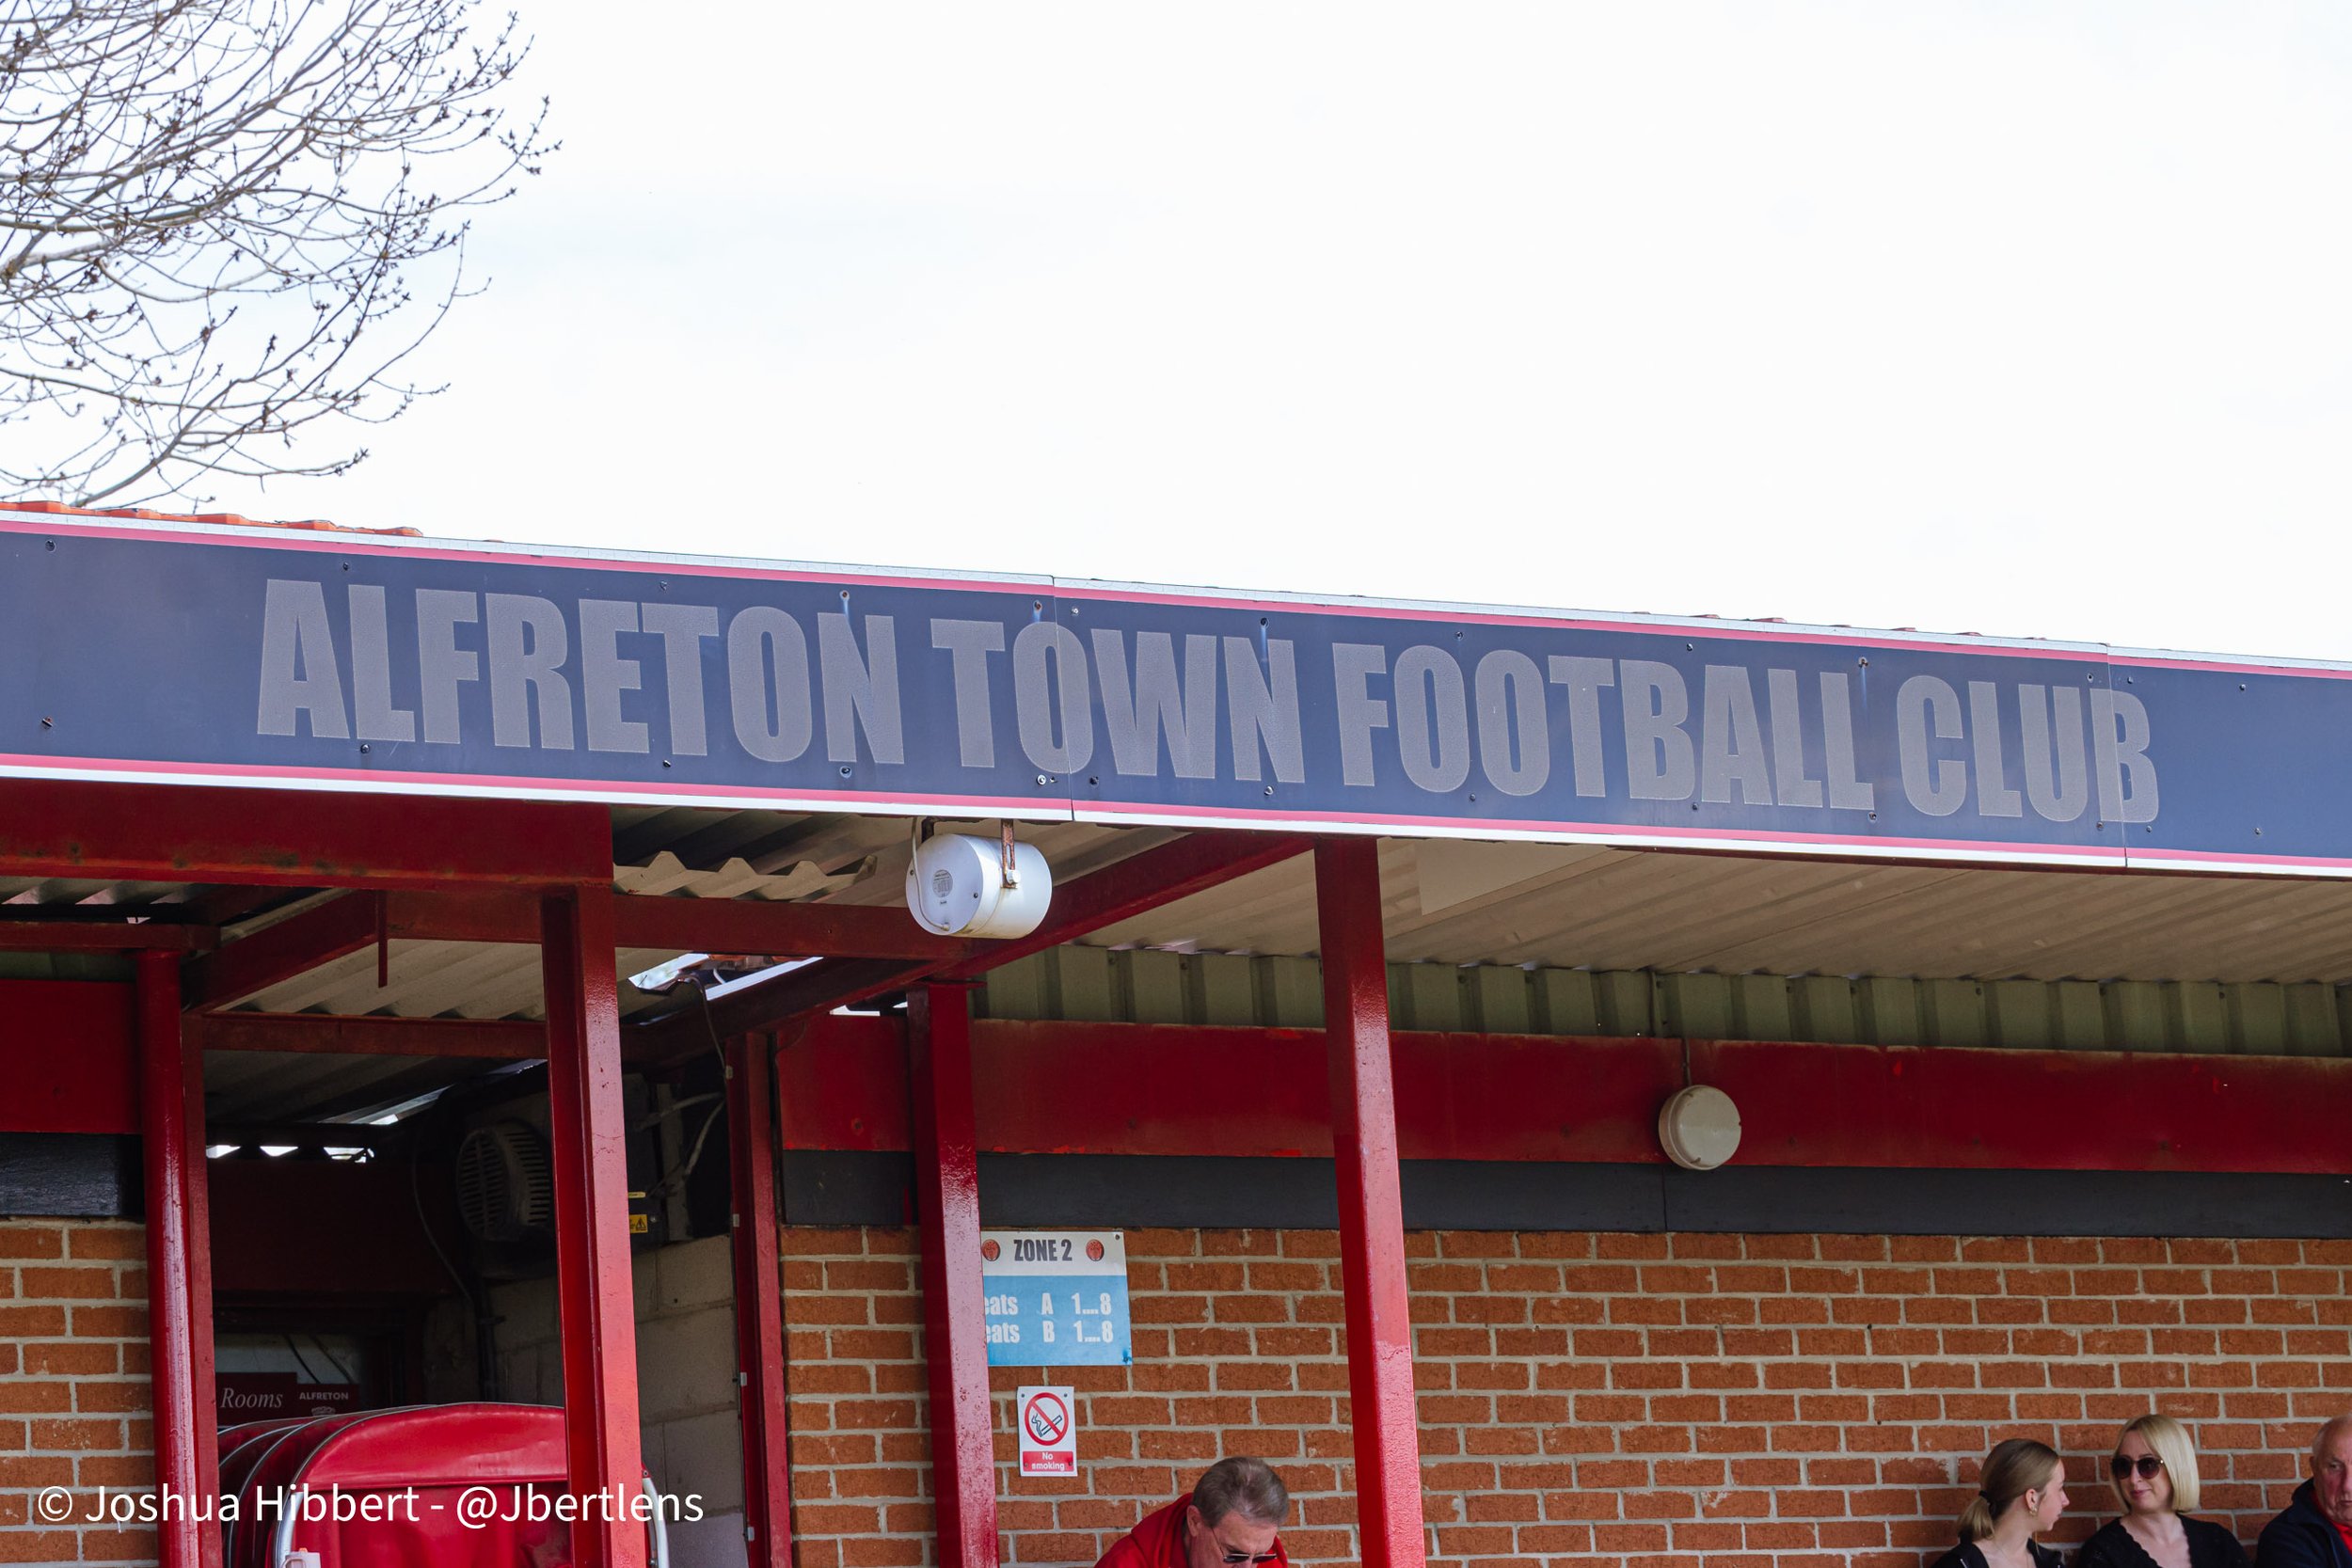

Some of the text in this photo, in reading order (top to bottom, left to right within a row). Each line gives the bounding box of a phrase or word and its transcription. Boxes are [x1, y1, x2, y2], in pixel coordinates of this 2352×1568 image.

[256, 578, 2160, 823] ALFRETON TOWN FOOTBALL CLUB
[1013, 1239, 1073, 1262] ZONE 2
[1041, 1292, 1054, 1315] A
[1042, 1320, 1056, 1343] B
[220, 1387, 282, 1409] Rooms
[299, 1392, 349, 1401] ALFRETON
[1031, 1461, 1065, 1471] smoking
[1041, 1451, 1054, 1461] No
